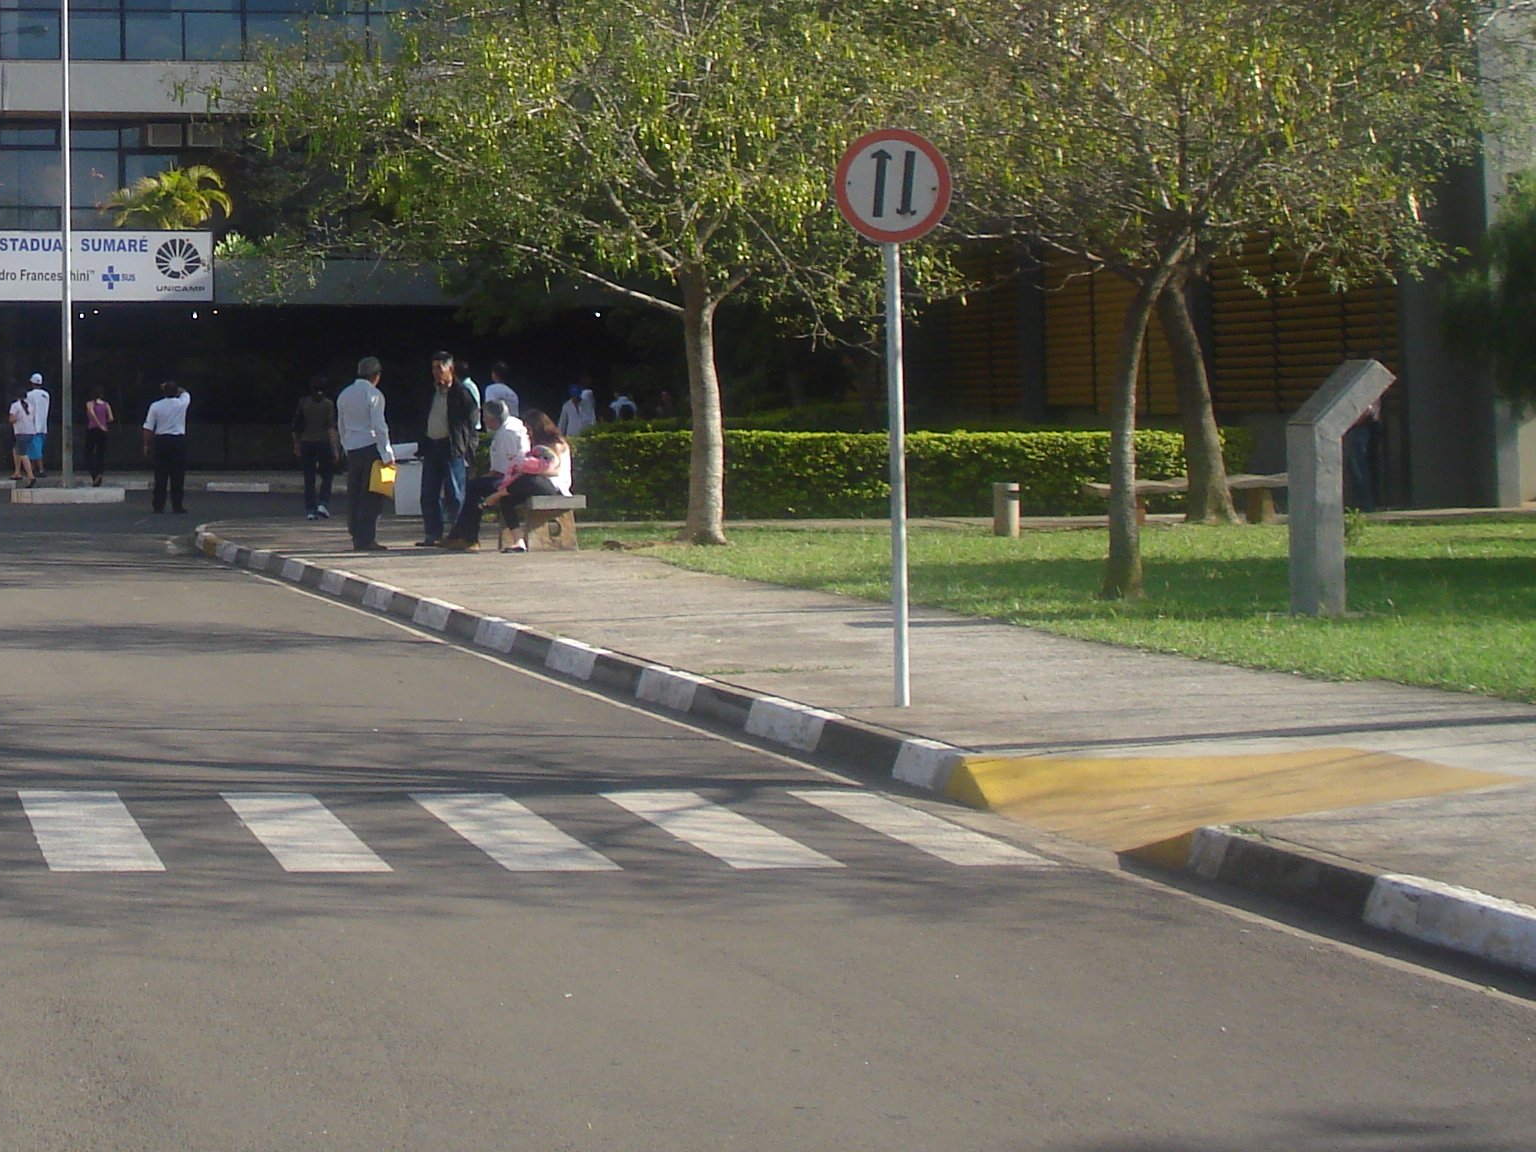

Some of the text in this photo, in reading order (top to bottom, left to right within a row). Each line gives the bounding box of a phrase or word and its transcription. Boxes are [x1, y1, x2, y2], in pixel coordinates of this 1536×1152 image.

[80, 236, 149, 253] SUMARÉ
[20, 269, 95, 282] Franceshini"
[121, 273, 136, 282] SUS
